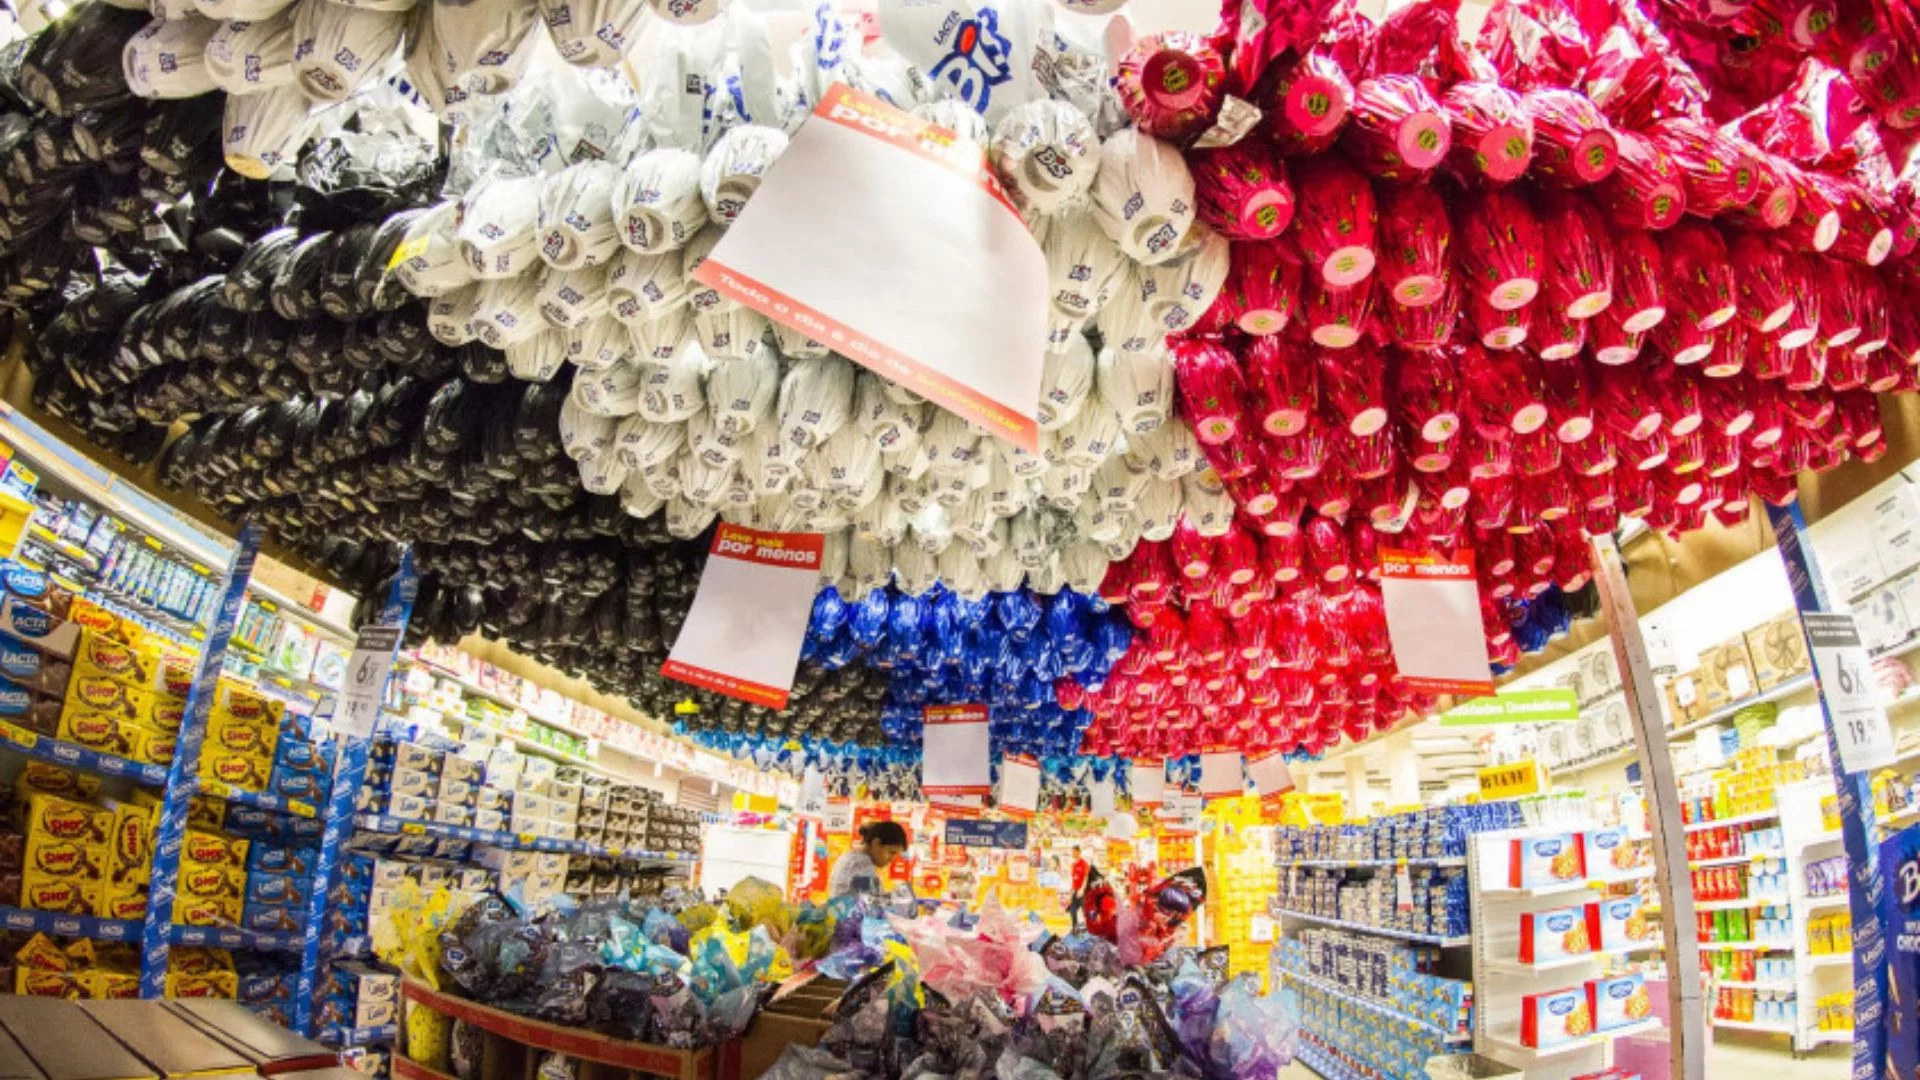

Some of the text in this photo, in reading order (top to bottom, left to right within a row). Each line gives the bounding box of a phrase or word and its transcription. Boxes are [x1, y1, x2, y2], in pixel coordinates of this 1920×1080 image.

[933, 9, 961, 46] LACTA
[719, 274, 770, 308] Todo
[794, 311, 826, 334] dia
[721, 528, 785, 549] Leve mais
[717, 539, 817, 563] por menos
[1383, 563, 1471, 577] por menos
[7, 569, 45, 588] LACTA
[2, 650, 40, 666] LACTA
[0, 691, 30, 707] ACTA
[86, 684, 118, 699] SHOT
[77, 720, 110, 736] SHOT
[227, 730, 253, 743] SHOT
[220, 763, 246, 775] SHOT
[280, 777, 309, 789] LACTA
[51, 819, 82, 831] SHOT
[127, 823, 137, 857] SHOT
[45, 852, 75, 864] SHOT
[194, 848, 223, 861] SHOT
[193, 875, 219, 888] SHOT
[258, 880, 285, 893] LACTA
[39, 890, 70, 903] SHOT
[249, 976, 277, 993] LACTA
